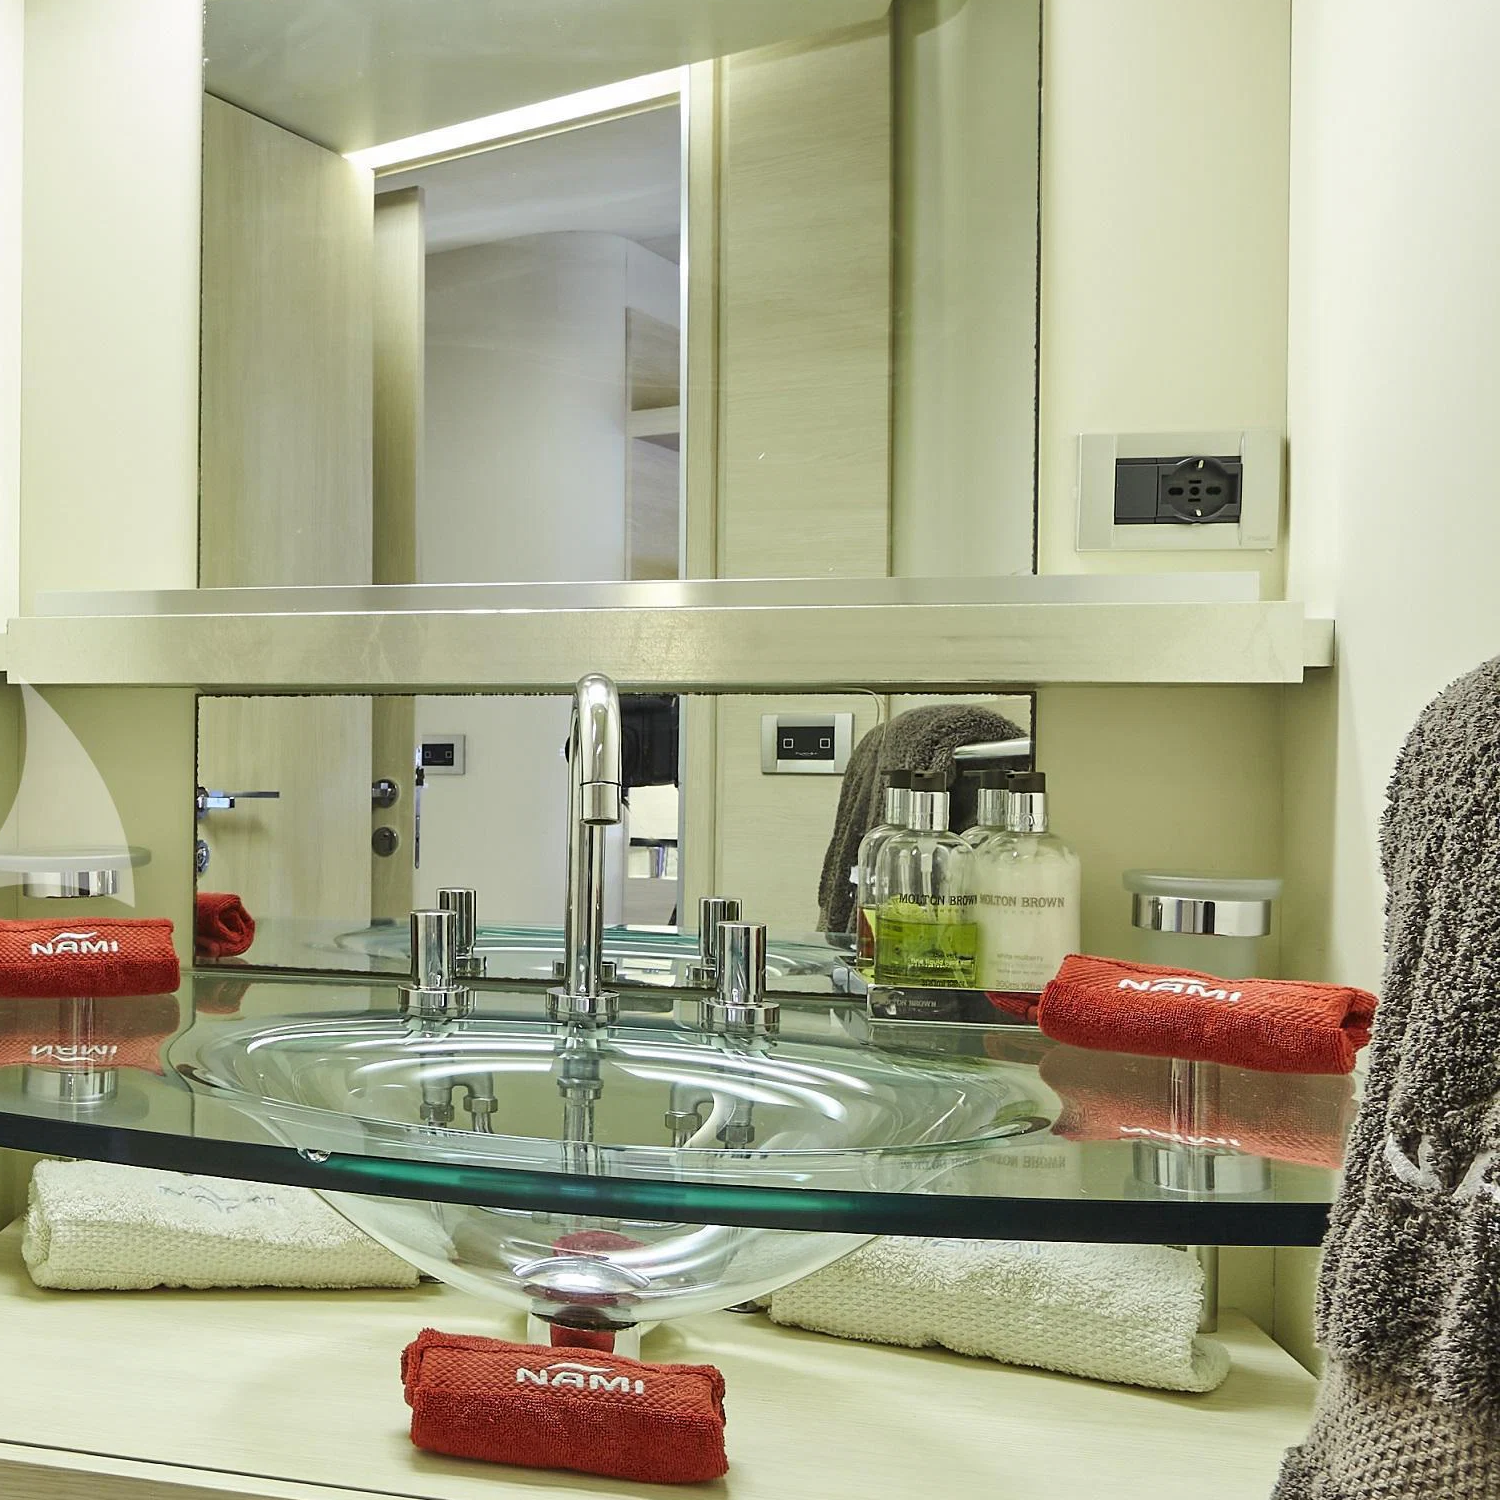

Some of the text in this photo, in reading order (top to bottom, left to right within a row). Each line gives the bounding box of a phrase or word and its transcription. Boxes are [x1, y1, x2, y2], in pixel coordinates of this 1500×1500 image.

[899, 893, 978, 906] MOLTON BROWN
[980, 893, 1065, 909] MOLTON BROWN
[30, 940, 119, 956] NAMI
[1117, 978, 1242, 1002] NAMI
[515, 1366, 645, 1396] NAMI
